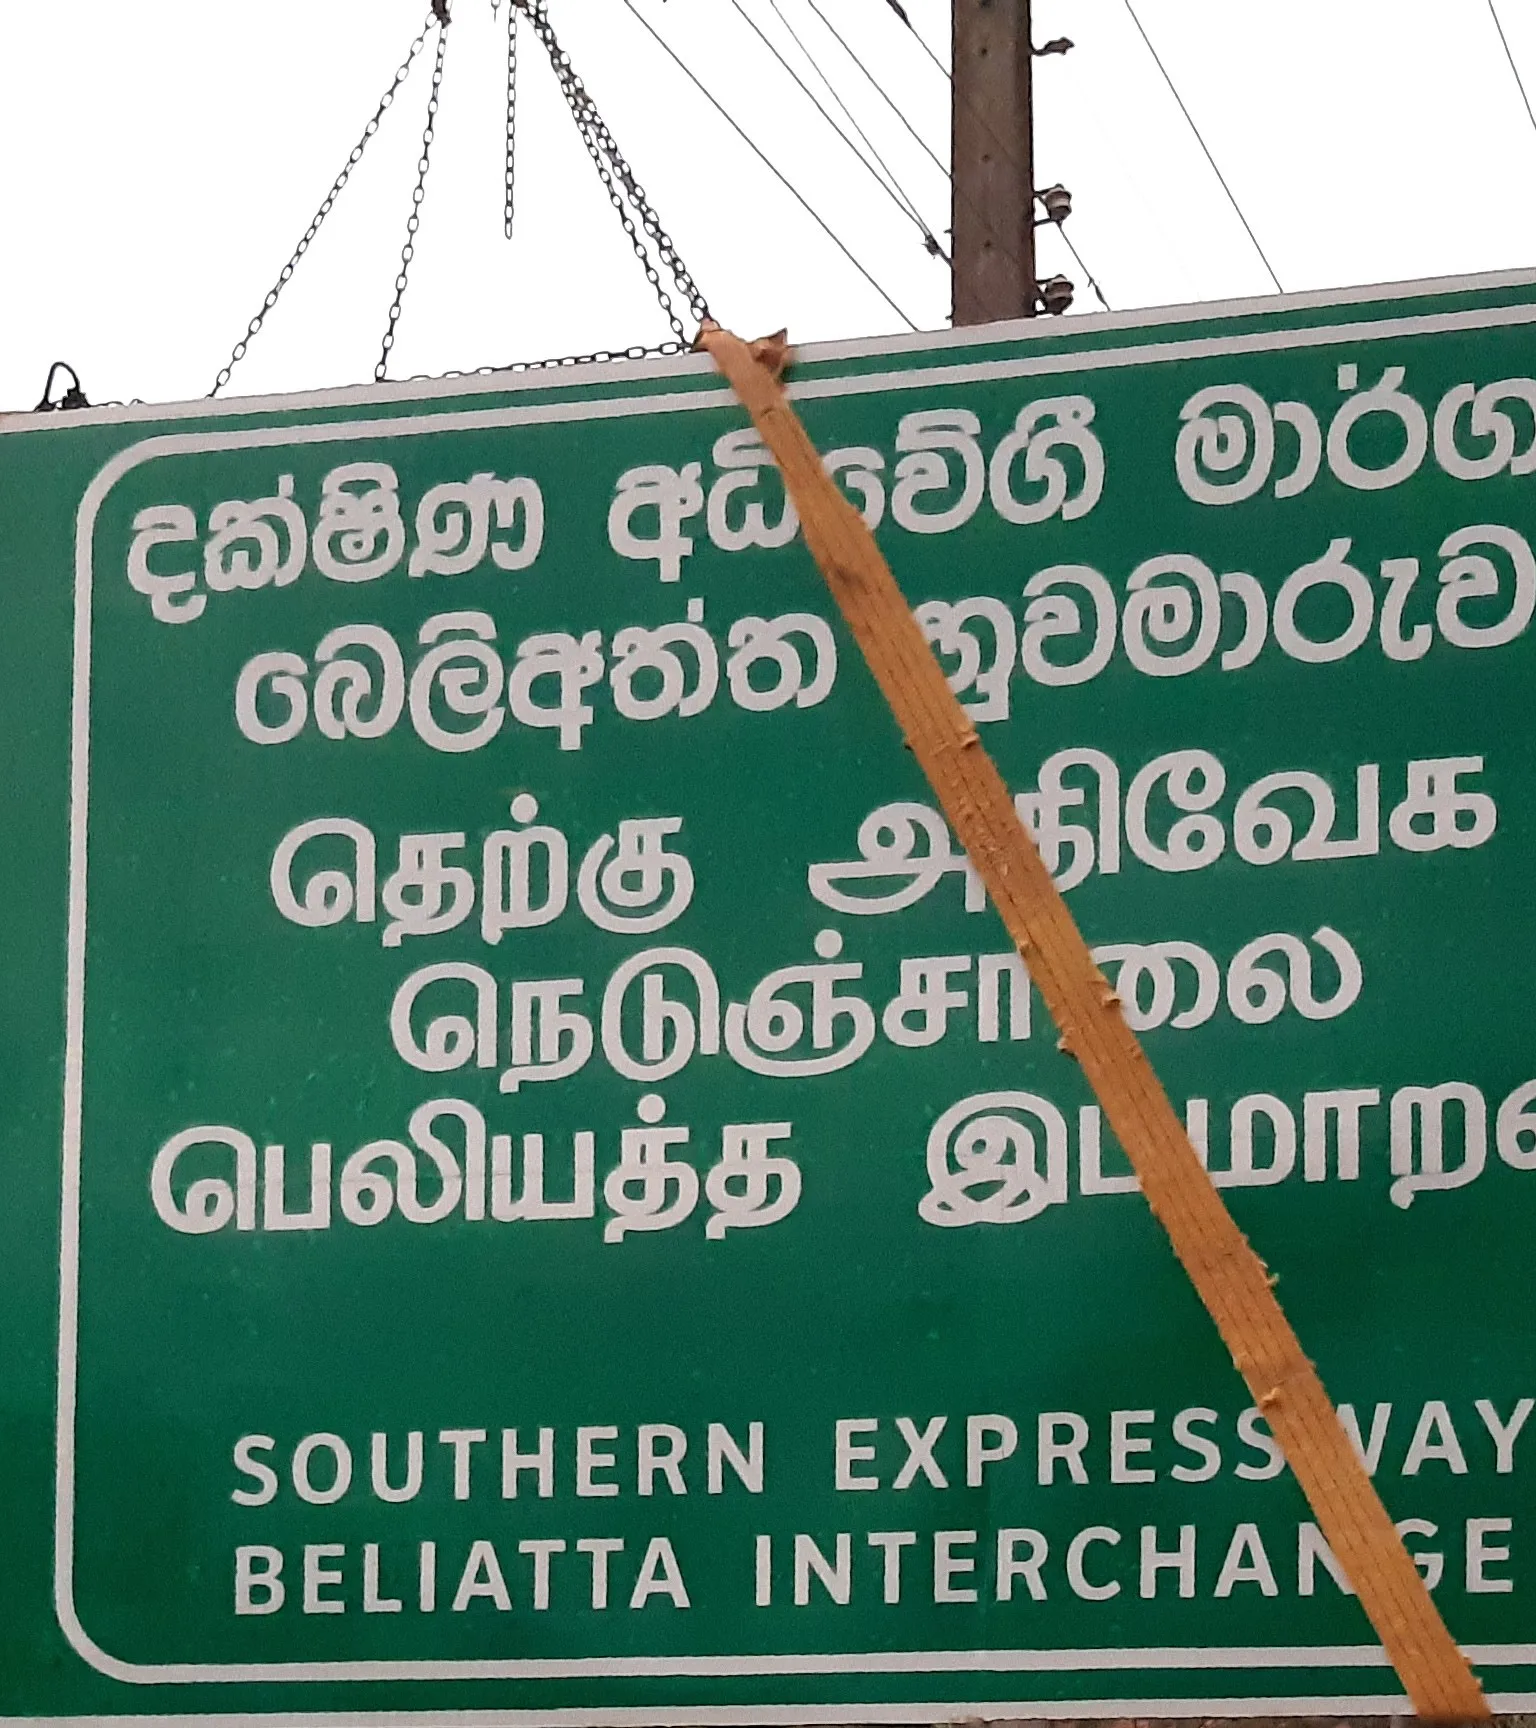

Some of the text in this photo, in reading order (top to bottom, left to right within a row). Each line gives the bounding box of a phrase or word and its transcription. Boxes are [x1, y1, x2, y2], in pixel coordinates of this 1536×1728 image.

[235, 598, 837, 752] බෙලිඅත්ත
[270, 794, 694, 947] தெற்கு
[150, 1094, 801, 1243] பெலியத்த
[232, 1422, 763, 1506] SOUTHERN
[235, 1538, 690, 1614] BELIATTA
